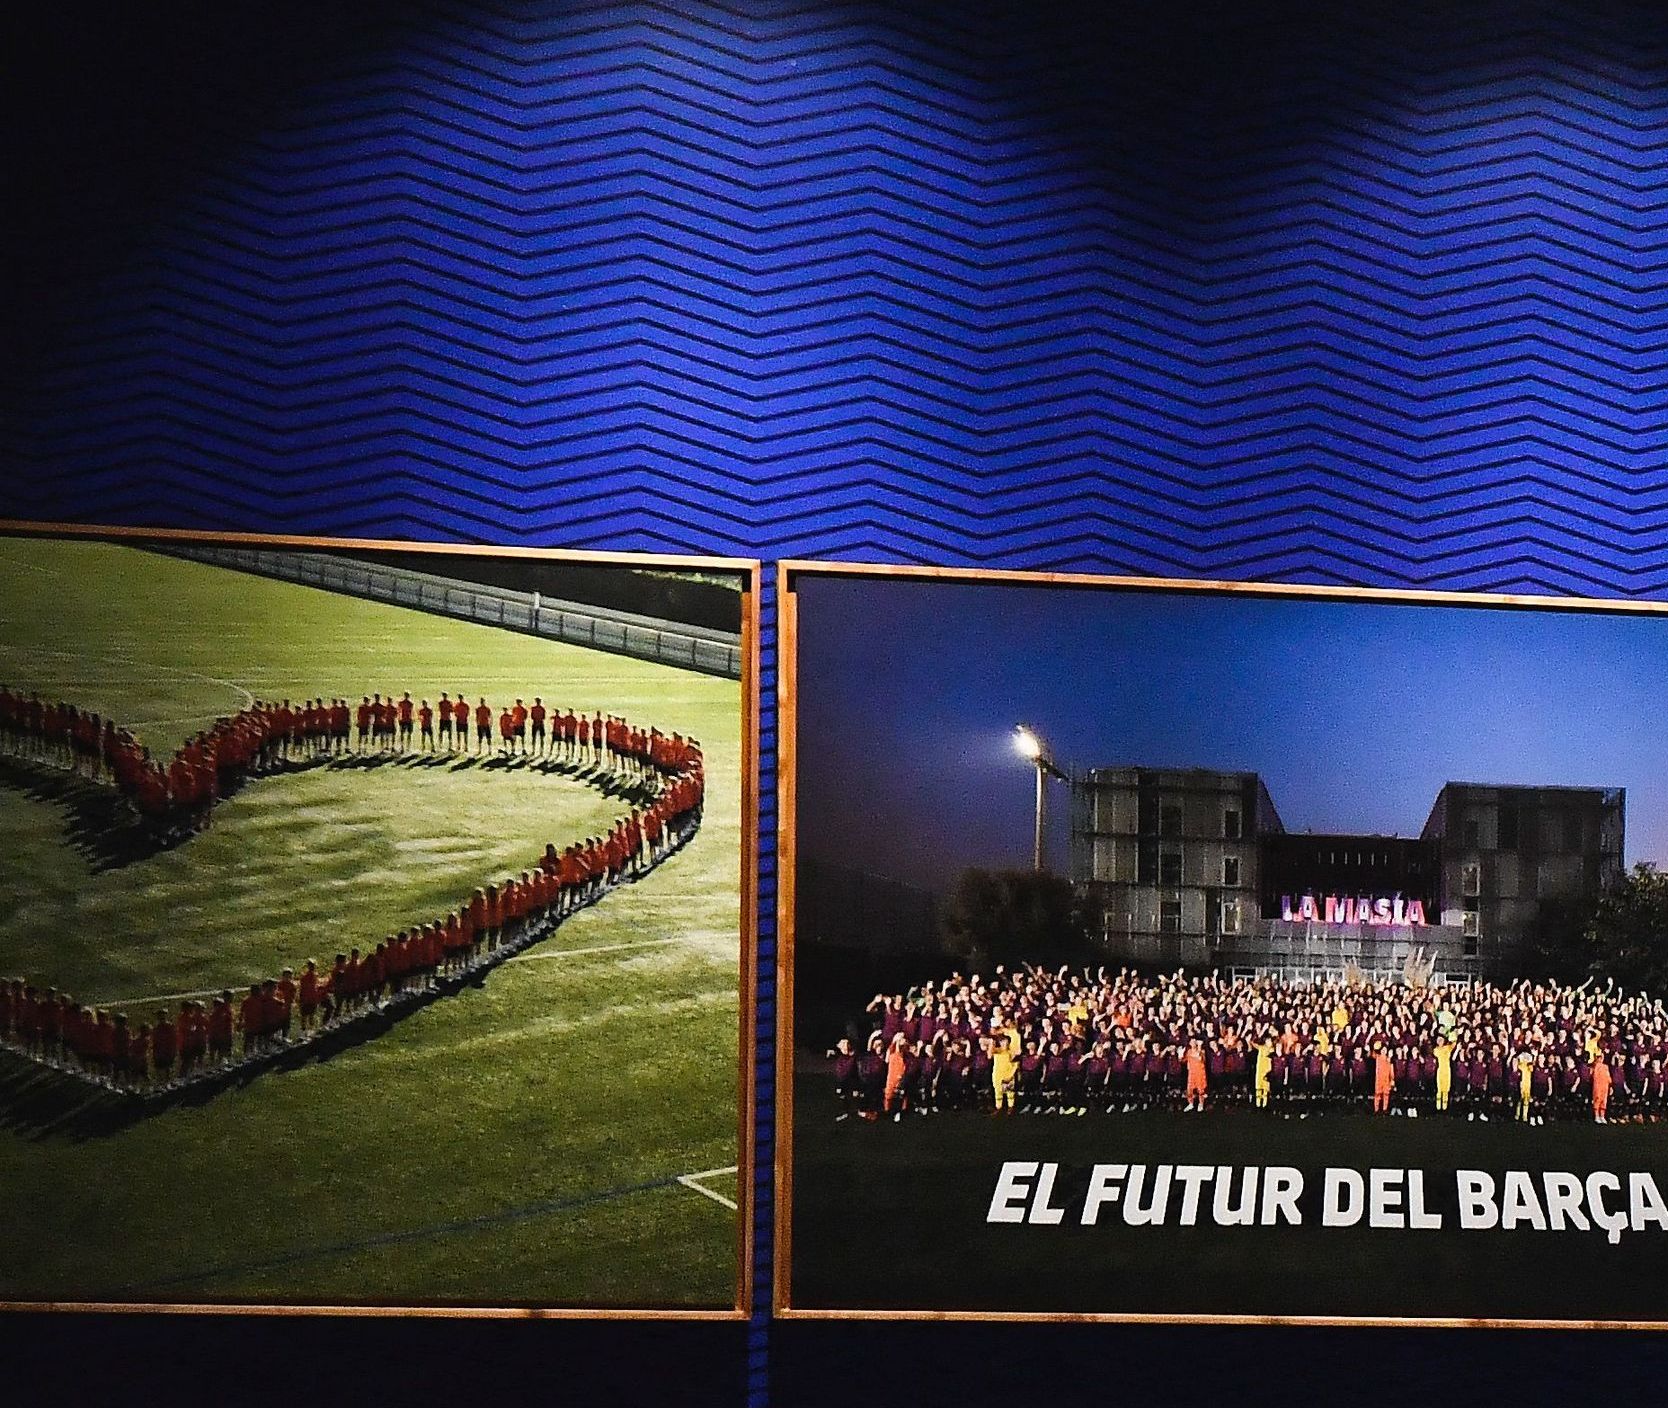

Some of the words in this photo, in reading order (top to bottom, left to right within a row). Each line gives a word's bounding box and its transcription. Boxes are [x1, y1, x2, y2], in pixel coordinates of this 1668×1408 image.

[1282, 895, 1319, 922] LA
[985, 1160, 1066, 1226] EL
[1079, 1162, 1305, 1227] FUTUR
[1321, 1166, 1443, 1231] DEL
